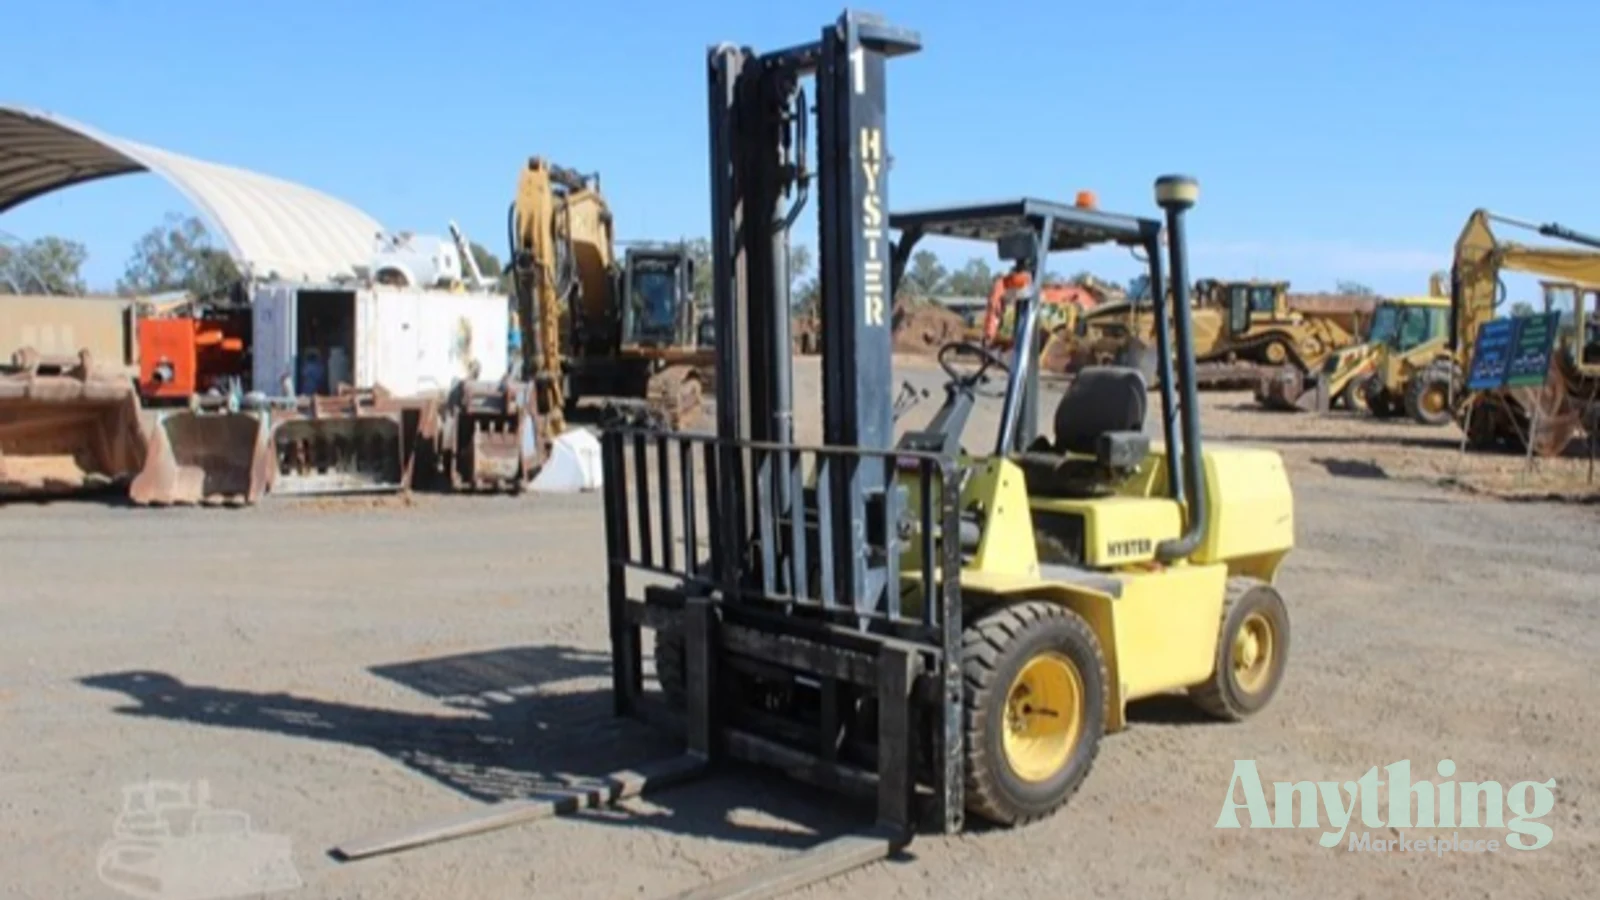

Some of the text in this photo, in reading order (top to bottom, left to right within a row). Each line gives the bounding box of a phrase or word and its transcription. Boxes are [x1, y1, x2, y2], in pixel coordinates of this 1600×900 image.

[849, 48, 866, 94] 1
[860, 127, 884, 327] HYSTER
[1107, 538, 1153, 558] HYSTER
